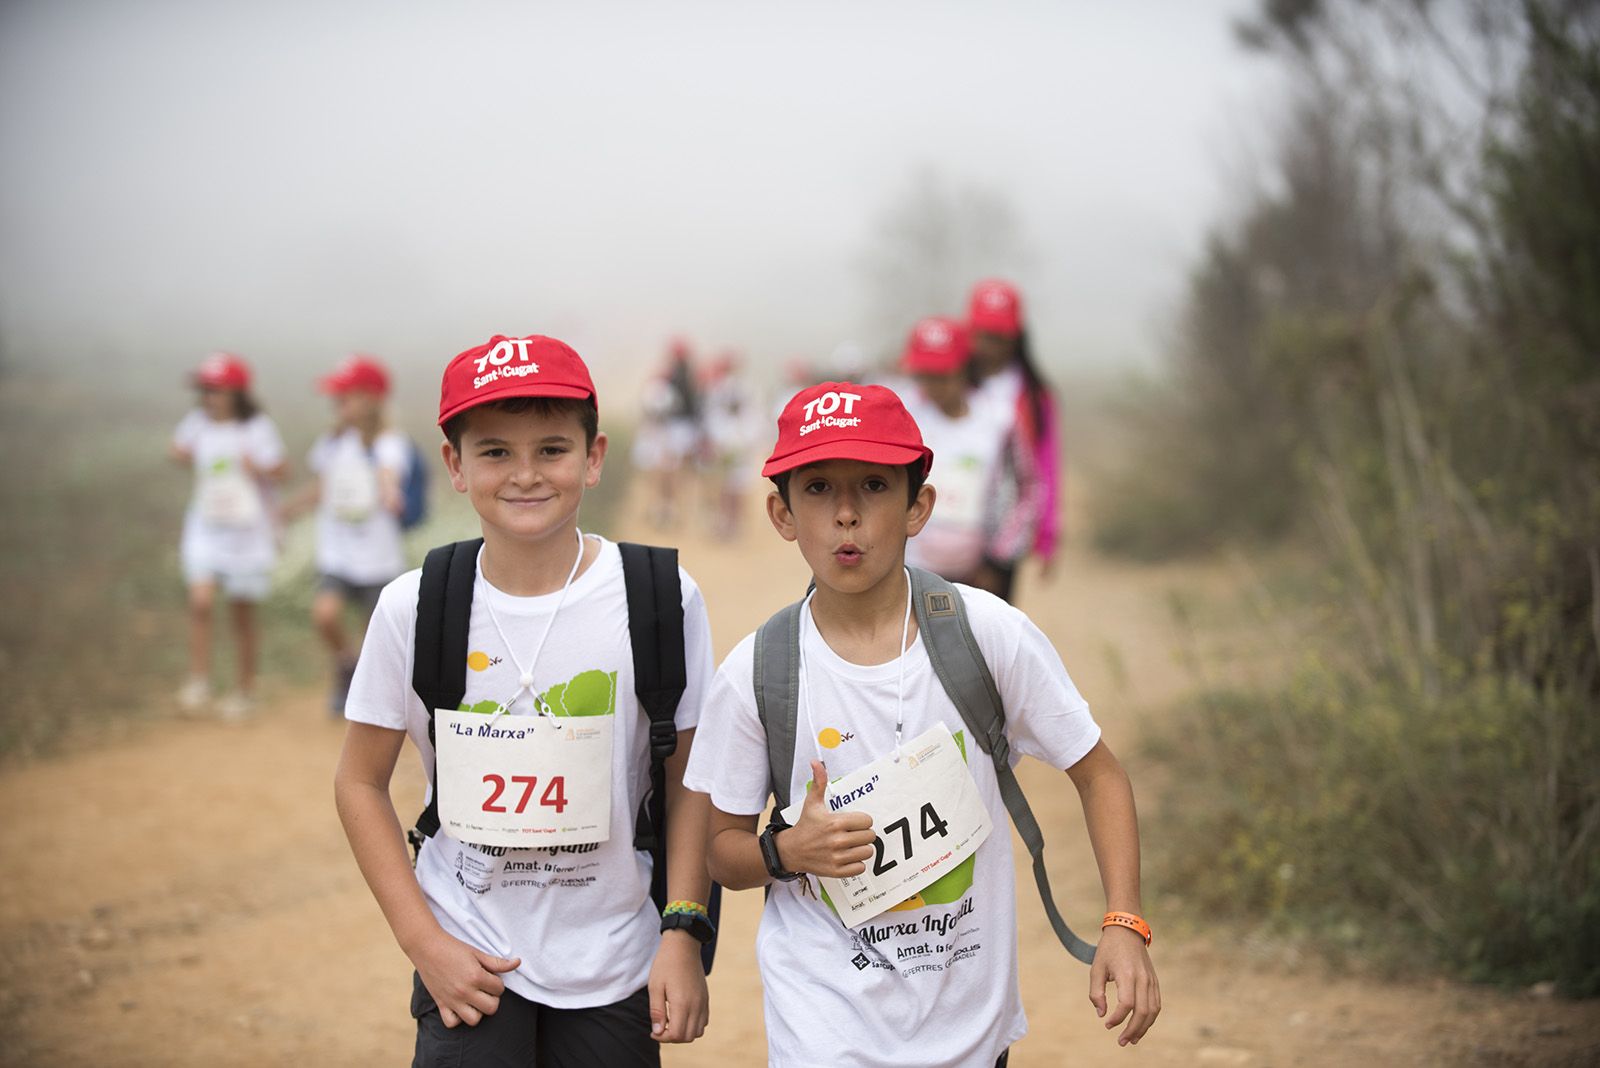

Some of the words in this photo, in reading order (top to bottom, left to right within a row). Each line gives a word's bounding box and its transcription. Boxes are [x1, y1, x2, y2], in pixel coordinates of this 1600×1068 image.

[474, 340, 533, 373] TOT
[474, 369, 499, 389] Sant
[803, 391, 862, 422] TOT
[800, 419, 821, 436] Sant
[482, 773, 568, 814] 274
[872, 802, 948, 877] 274
[504, 861, 541, 871] Amat.
[859, 921, 919, 944] Marxa
[896, 942, 933, 960] Amat.
[908, 964, 943, 975] FERTRES
